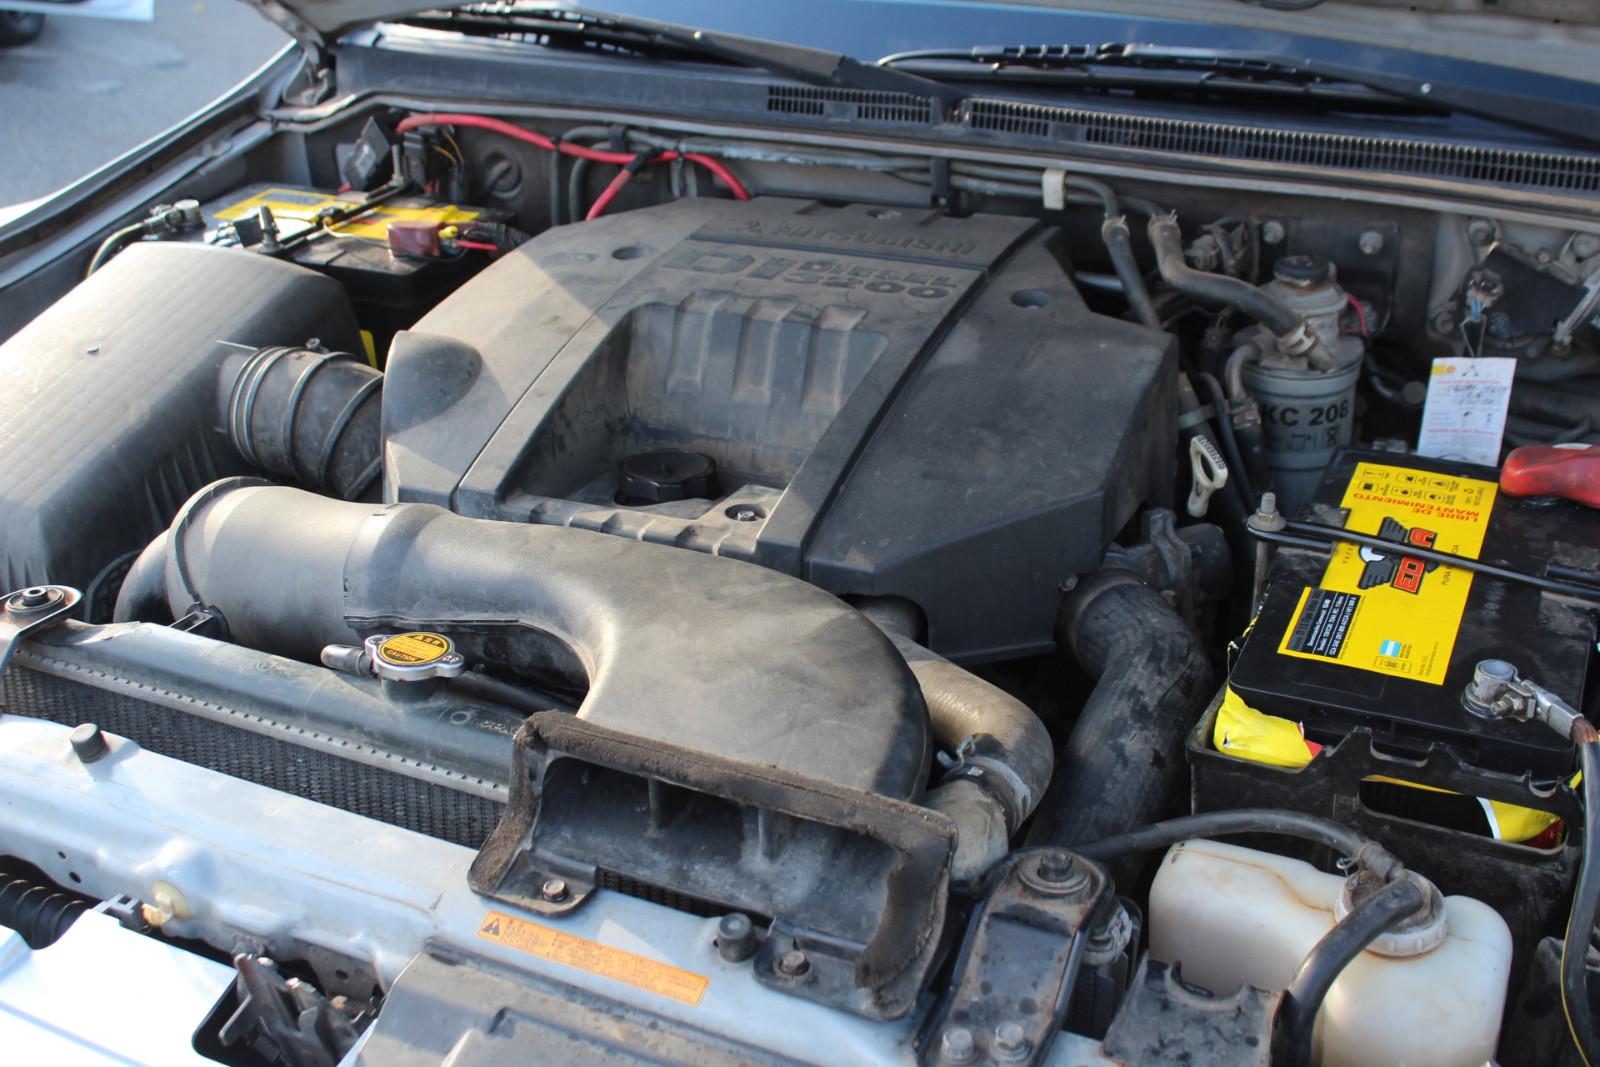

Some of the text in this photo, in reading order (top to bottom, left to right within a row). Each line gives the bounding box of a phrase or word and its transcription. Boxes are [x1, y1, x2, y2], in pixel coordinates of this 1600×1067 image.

[1308, 399, 1349, 427] 208
[1352, 493, 1480, 517] MANTENIMIENTO
[1392, 527, 1436, 594] EDA
